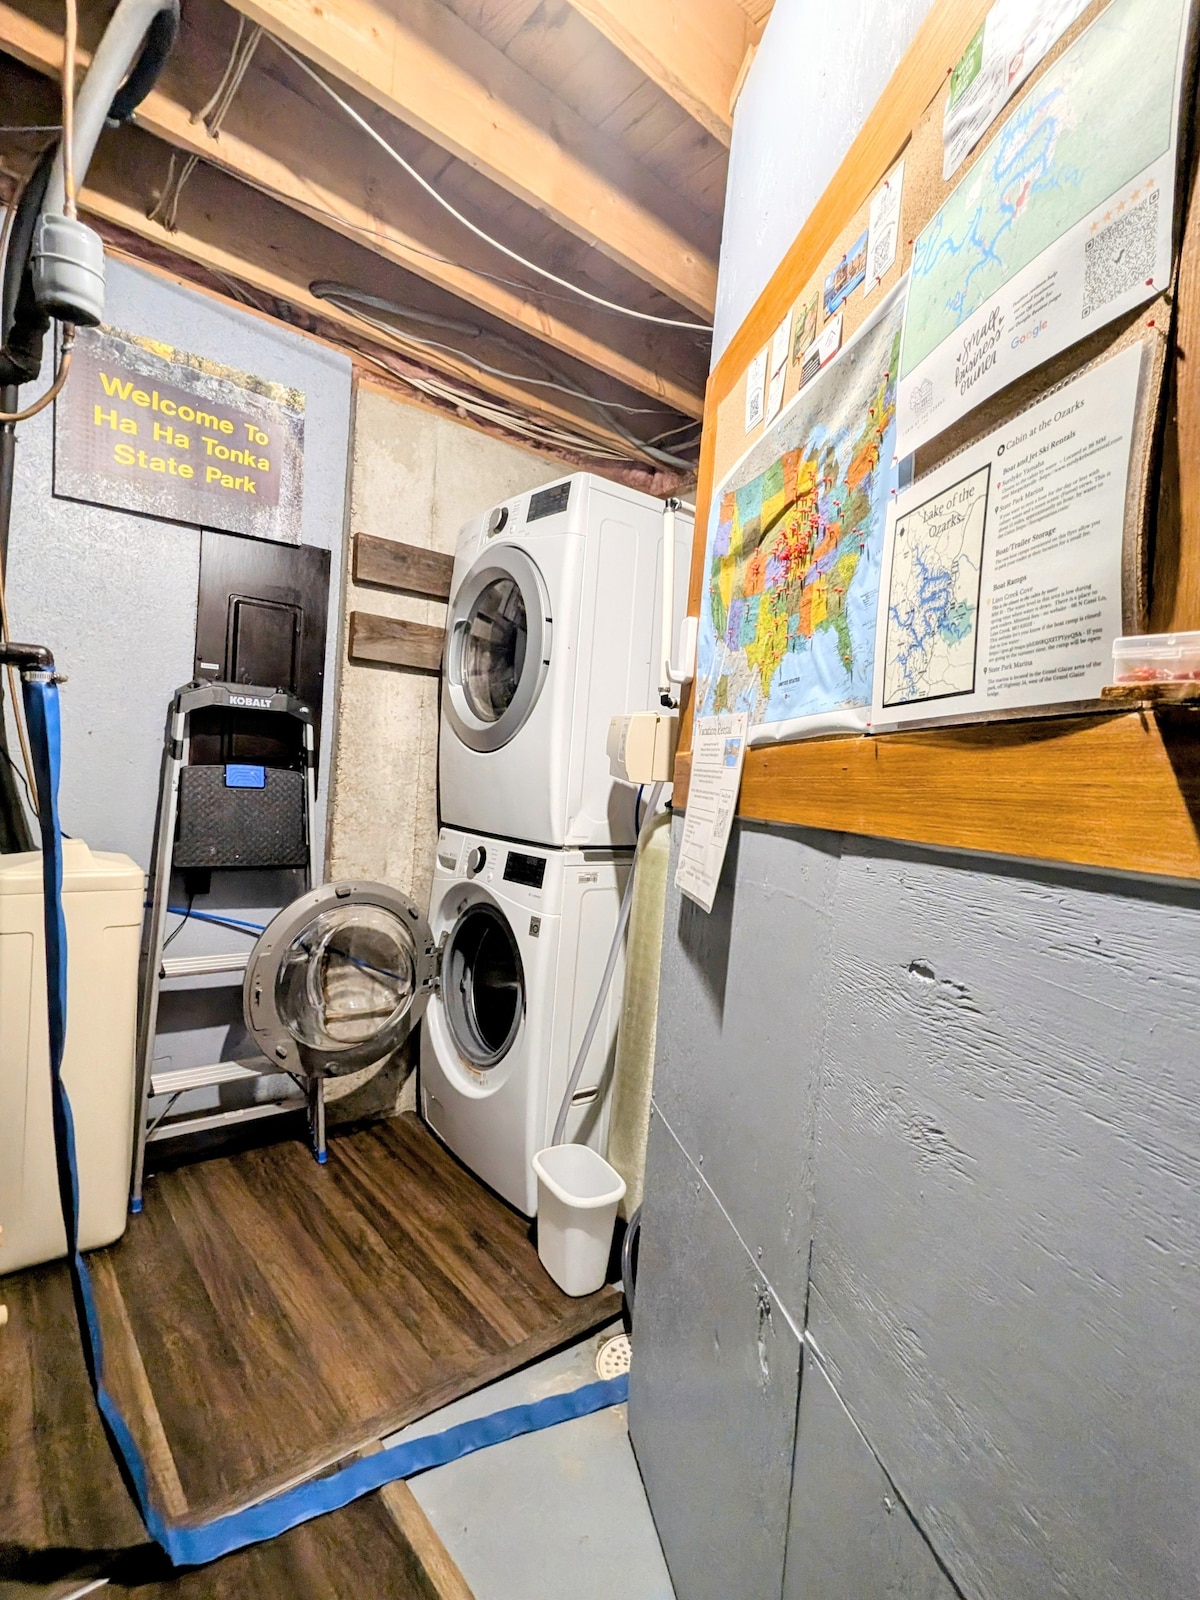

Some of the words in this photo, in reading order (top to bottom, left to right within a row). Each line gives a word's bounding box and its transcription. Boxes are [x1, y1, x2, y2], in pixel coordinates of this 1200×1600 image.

[962, 306, 1000, 366] Small
[1011, 320, 1048, 349] Google
[954, 330, 1002, 388] business
[960, 350, 997, 396] owner
[100, 372, 234, 435] Welcome
[244, 422, 269, 446] To
[1006, 433, 1028, 450] Cabin
[1029, 426, 1037, 436] at
[1038, 418, 1052, 432] the
[1053, 398, 1085, 422] Ozarks
[94, 405, 138, 436] Ha
[153, 422, 190, 450] Ha
[202, 436, 270, 472] Tonka
[1002, 464, 1015, 473] Boat
[1016, 457, 1028, 466] and
[1028, 452, 1038, 461] Jet
[1038, 446, 1049, 454] Ski
[1050, 432, 1075, 448] Rentals
[113, 444, 194, 478] State
[205, 466, 256, 494] Park
[923, 504, 944, 523] Lake
[946, 492, 958, 510] of
[959, 486, 975, 503] the
[1000, 502, 1011, 510] State
[1012, 496, 1023, 504] Park
[1025, 486, 1043, 498] Marina
[928, 515, 960, 538] Ozarks
[995, 539, 1030, 555] Boat/Trailer
[1032, 528, 1055, 542] Storage
[993, 582, 1005, 590] Boat
[1006, 575, 1026, 587] Ramps
[230, 695, 272, 708] KOBALT
